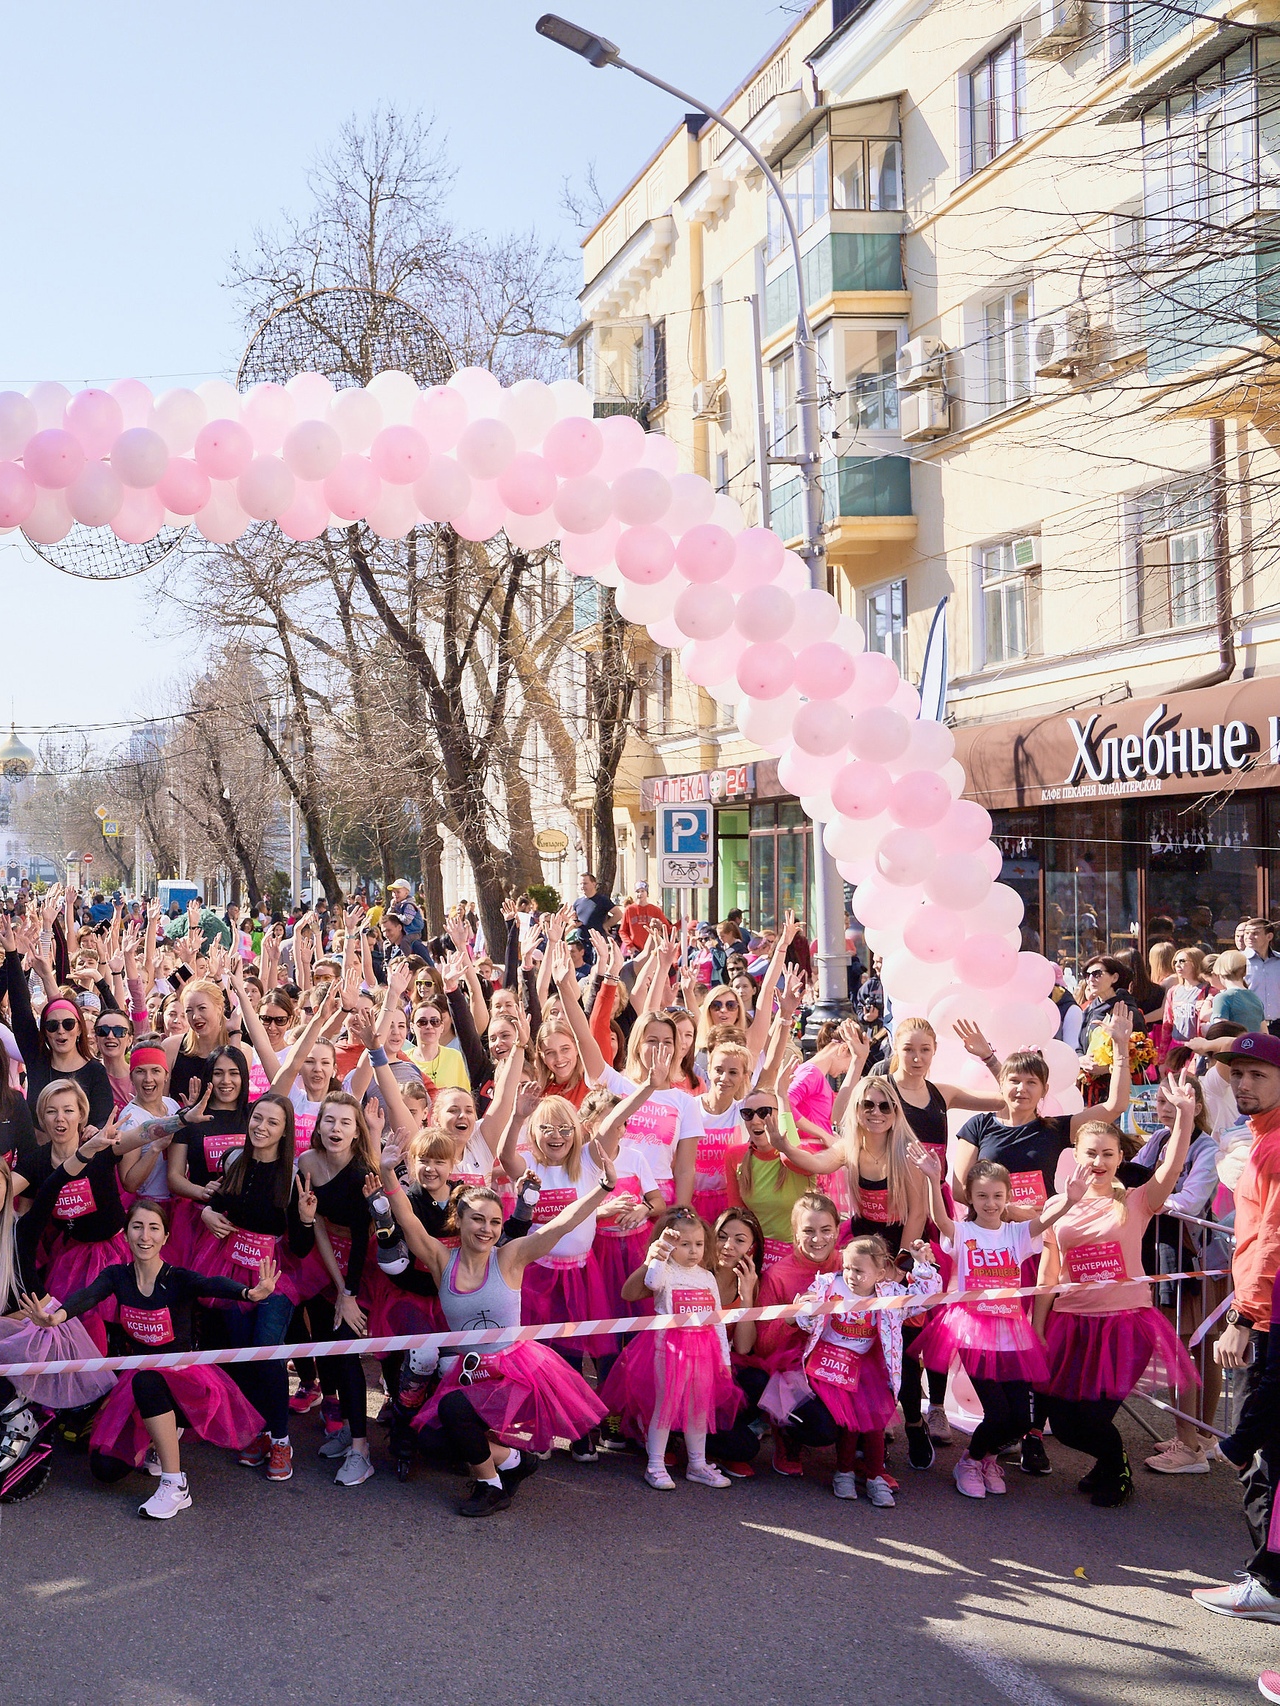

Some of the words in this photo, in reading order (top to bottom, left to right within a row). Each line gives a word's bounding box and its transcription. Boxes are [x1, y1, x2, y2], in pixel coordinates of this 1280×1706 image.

[1064, 703, 1250, 784] Хлебные
[653, 774, 705, 806] АПТЕКА
[725, 766, 748, 796] 24
[1041, 788, 1061, 801] КАФЕ
[1062, 784, 1097, 799] ПЕКАРНЯ
[1098, 779, 1161, 797] КОНДИТЕРСКАЯ
[671, 811, 699, 852] P
[234, 1241, 261, 1257] АЛЁНА
[1071, 1259, 1119, 1273] ЕКАТЕРИНА
[126, 1321, 163, 1332] КСЕНИЯ
[820, 1357, 850, 1374] ЗЛАТА
